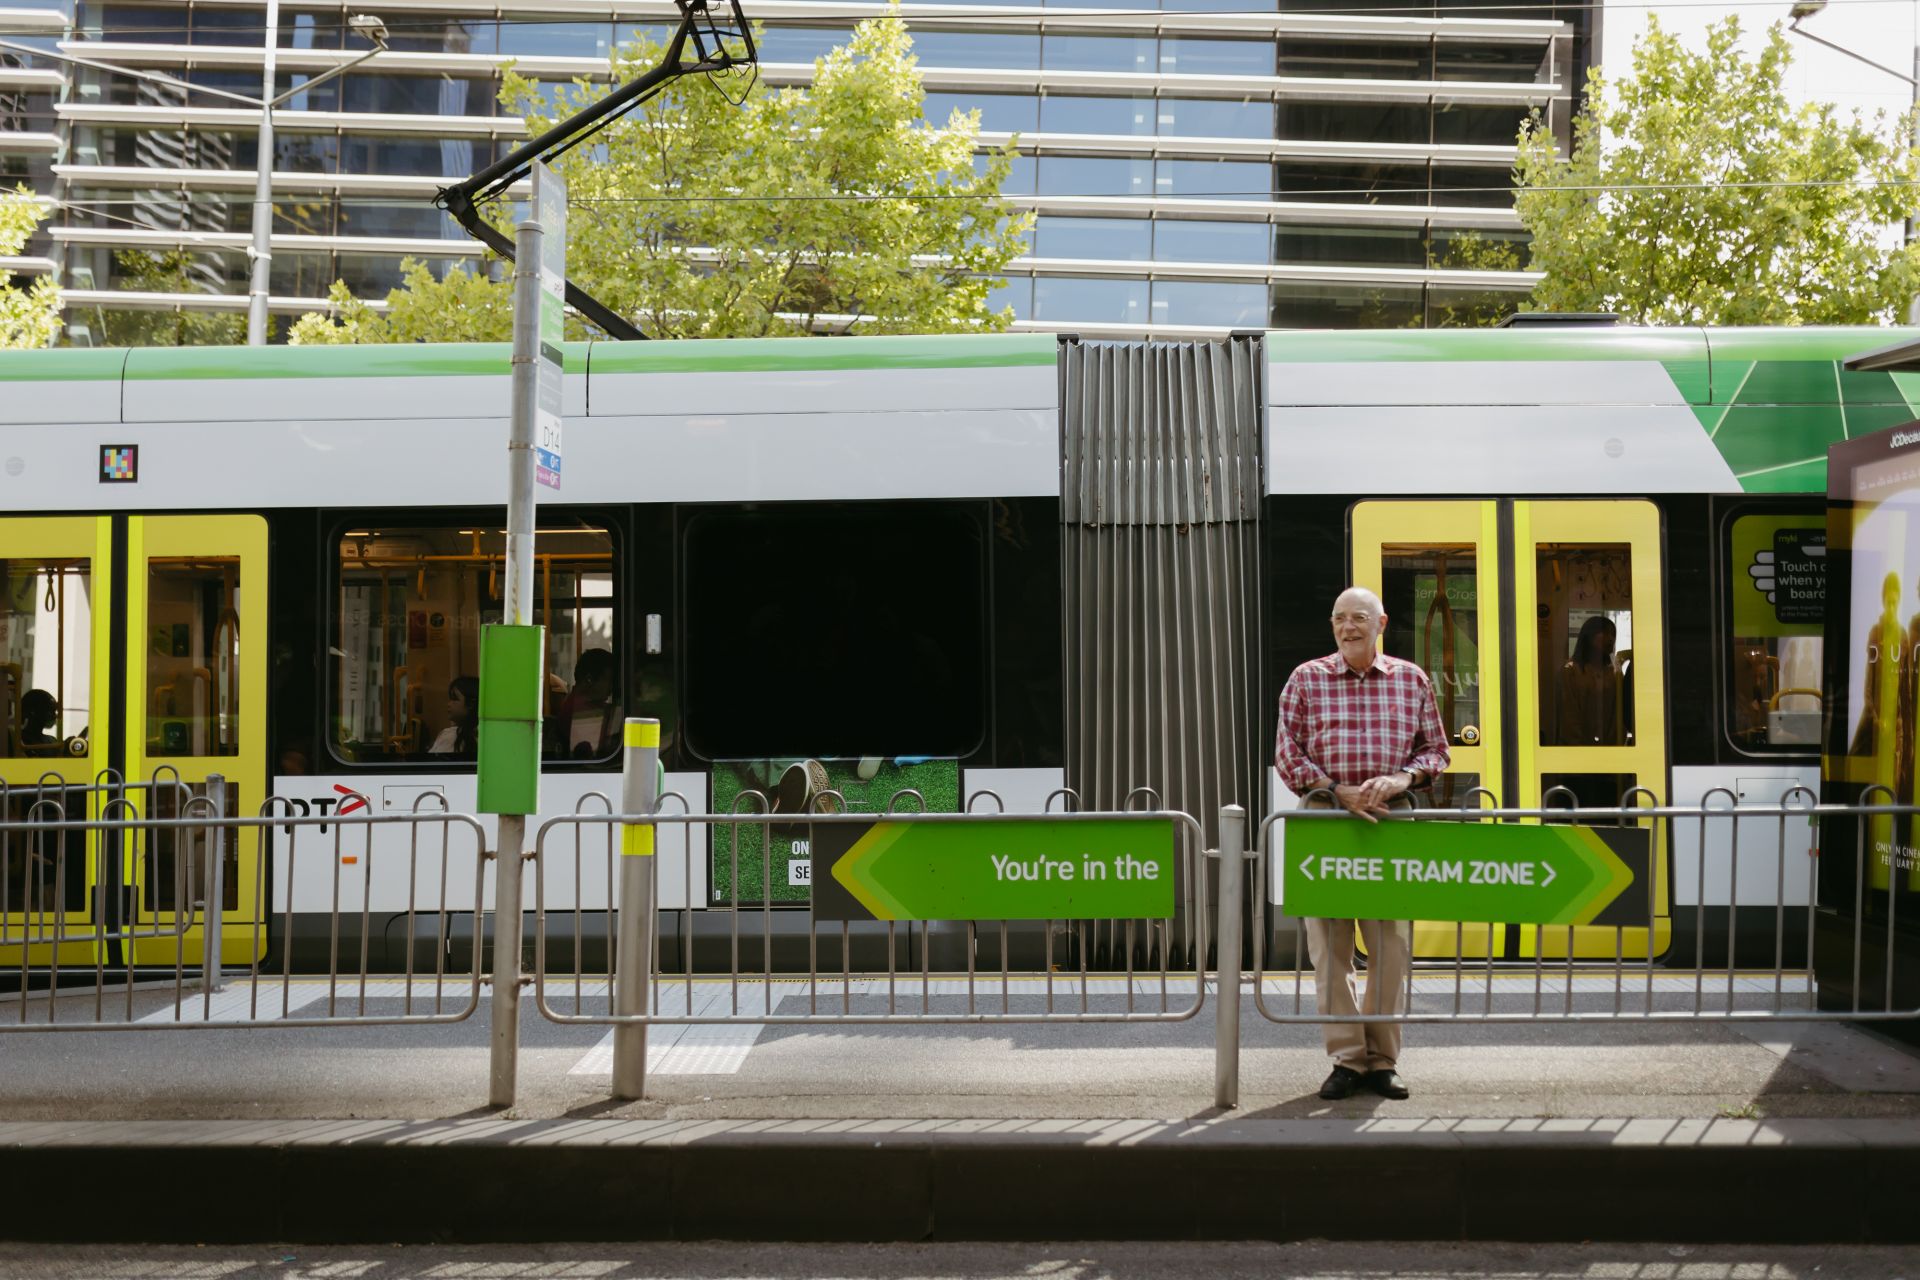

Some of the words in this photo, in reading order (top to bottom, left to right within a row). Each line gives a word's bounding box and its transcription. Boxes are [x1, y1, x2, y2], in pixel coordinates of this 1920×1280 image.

[543, 426, 560, 449] D14
[1780, 561, 1817, 572] Touch
[1779, 575, 1812, 586] when
[795, 866, 810, 880] SE
[990, 854, 1075, 881] You're
[1083, 853, 1106, 881] in
[1114, 854, 1159, 880] the
[1320, 856, 1384, 881] FREE
[1390, 858, 1463, 884] TRAM
[1468, 860, 1535, 886] ZONE
